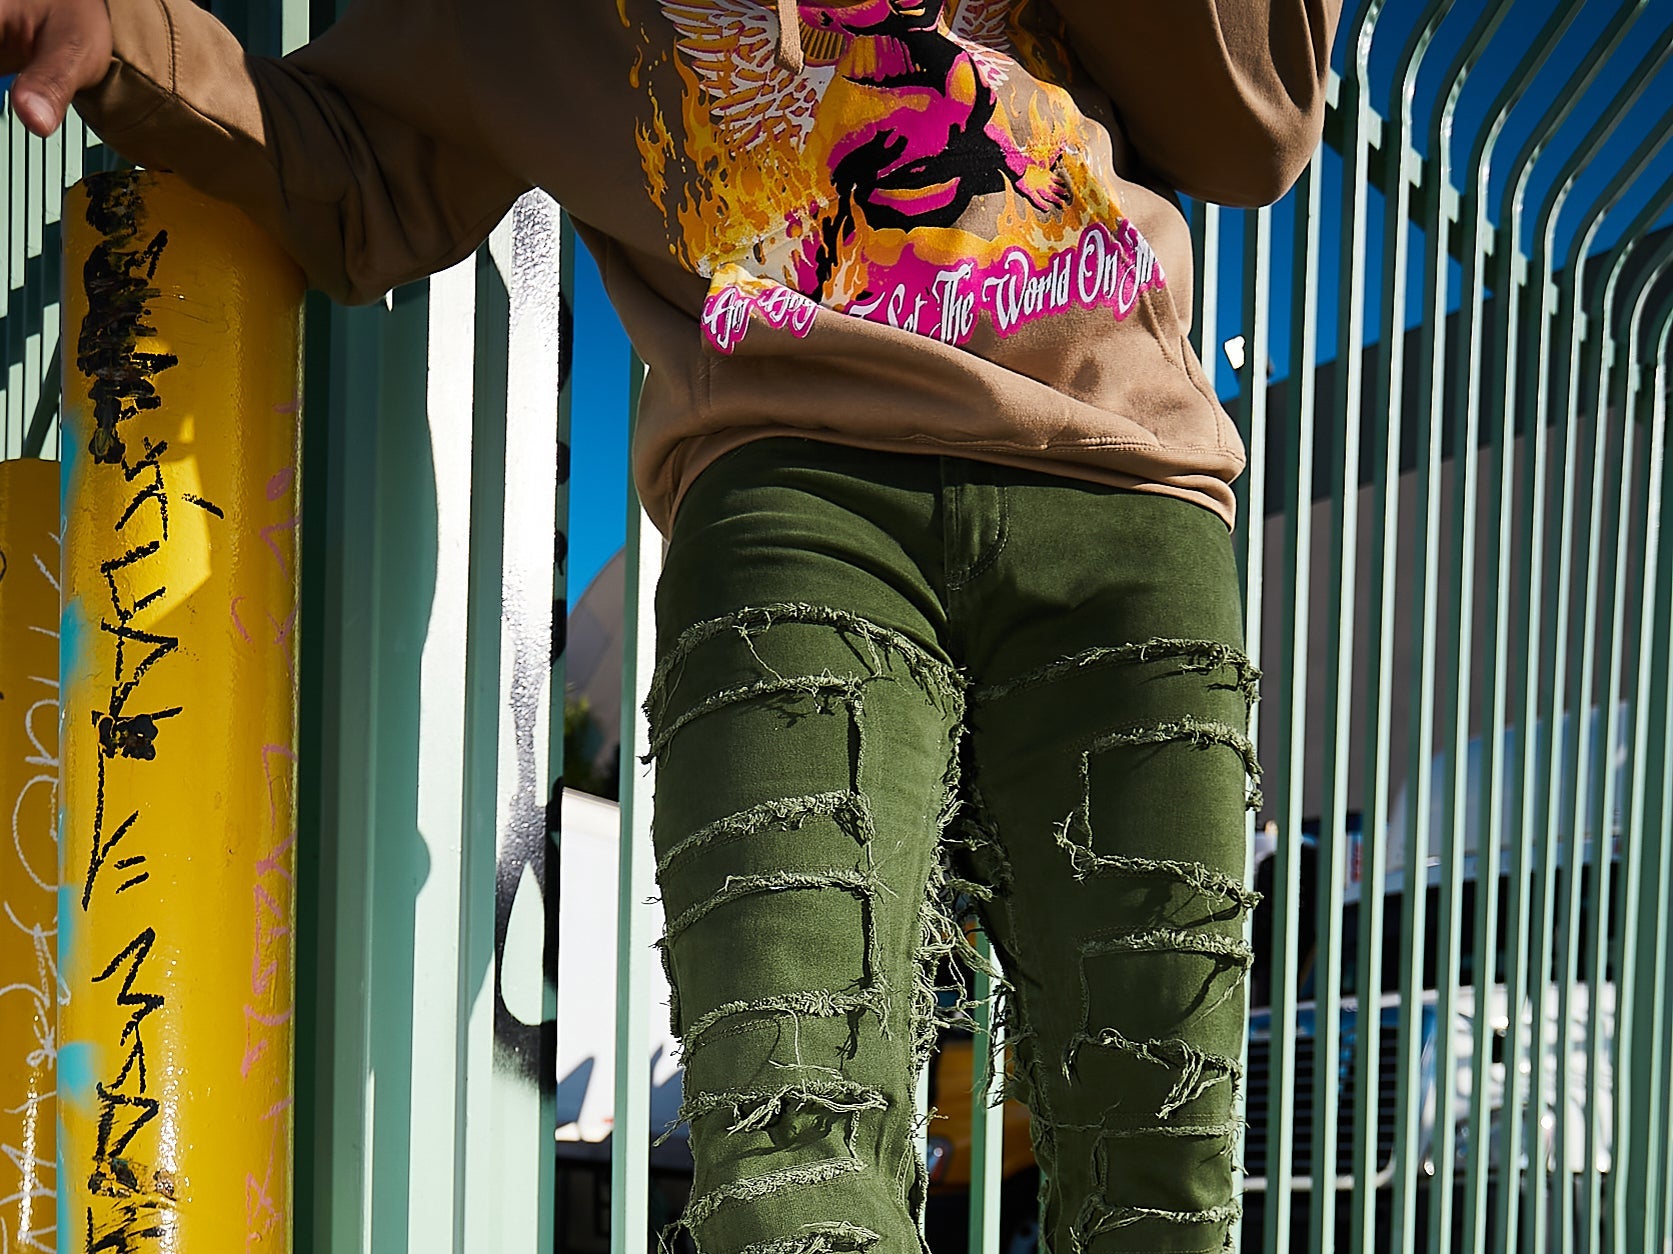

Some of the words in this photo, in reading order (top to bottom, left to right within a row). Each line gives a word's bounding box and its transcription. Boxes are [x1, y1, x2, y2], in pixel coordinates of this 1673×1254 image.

[928, 262, 976, 346] The
[982, 251, 1072, 330] World
[1078, 229, 1119, 303] On
